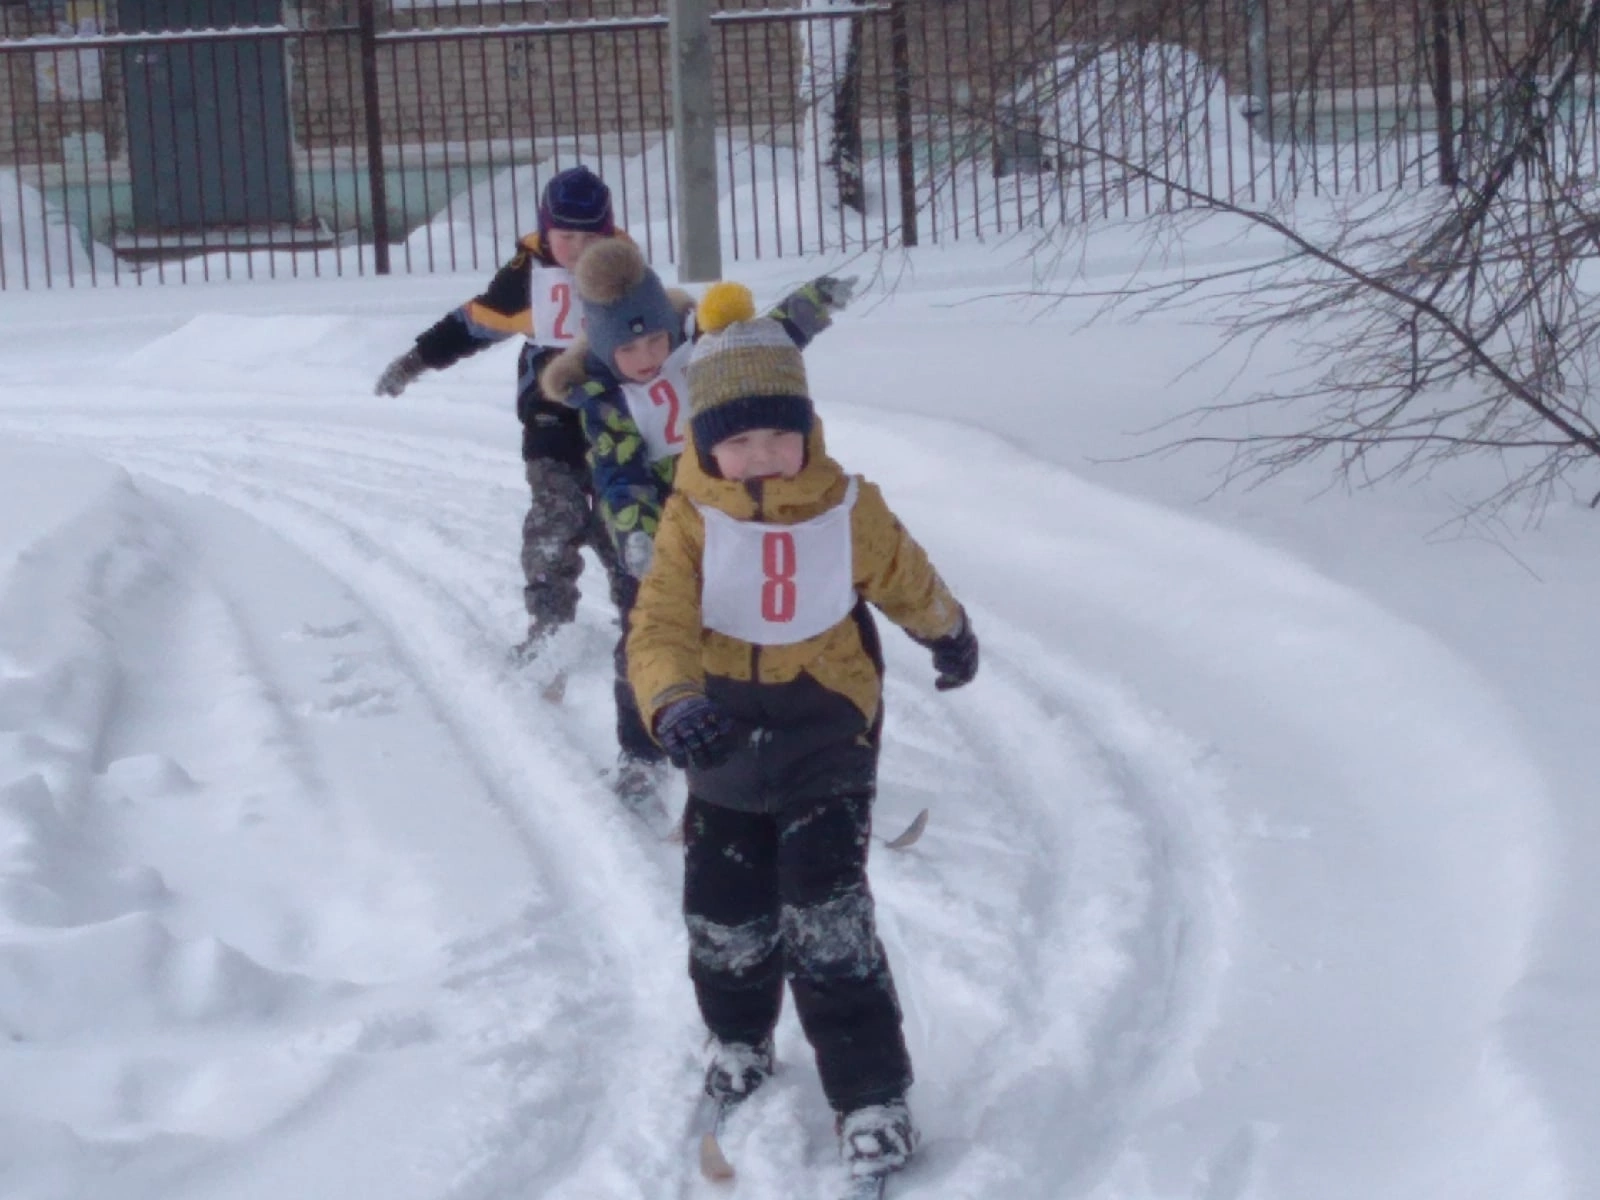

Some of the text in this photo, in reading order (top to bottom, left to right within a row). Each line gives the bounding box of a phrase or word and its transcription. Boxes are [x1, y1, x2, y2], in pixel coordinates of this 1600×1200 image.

[551, 284, 585, 340] 2
[649, 366, 687, 444] 2
[761, 531, 796, 623] 8
